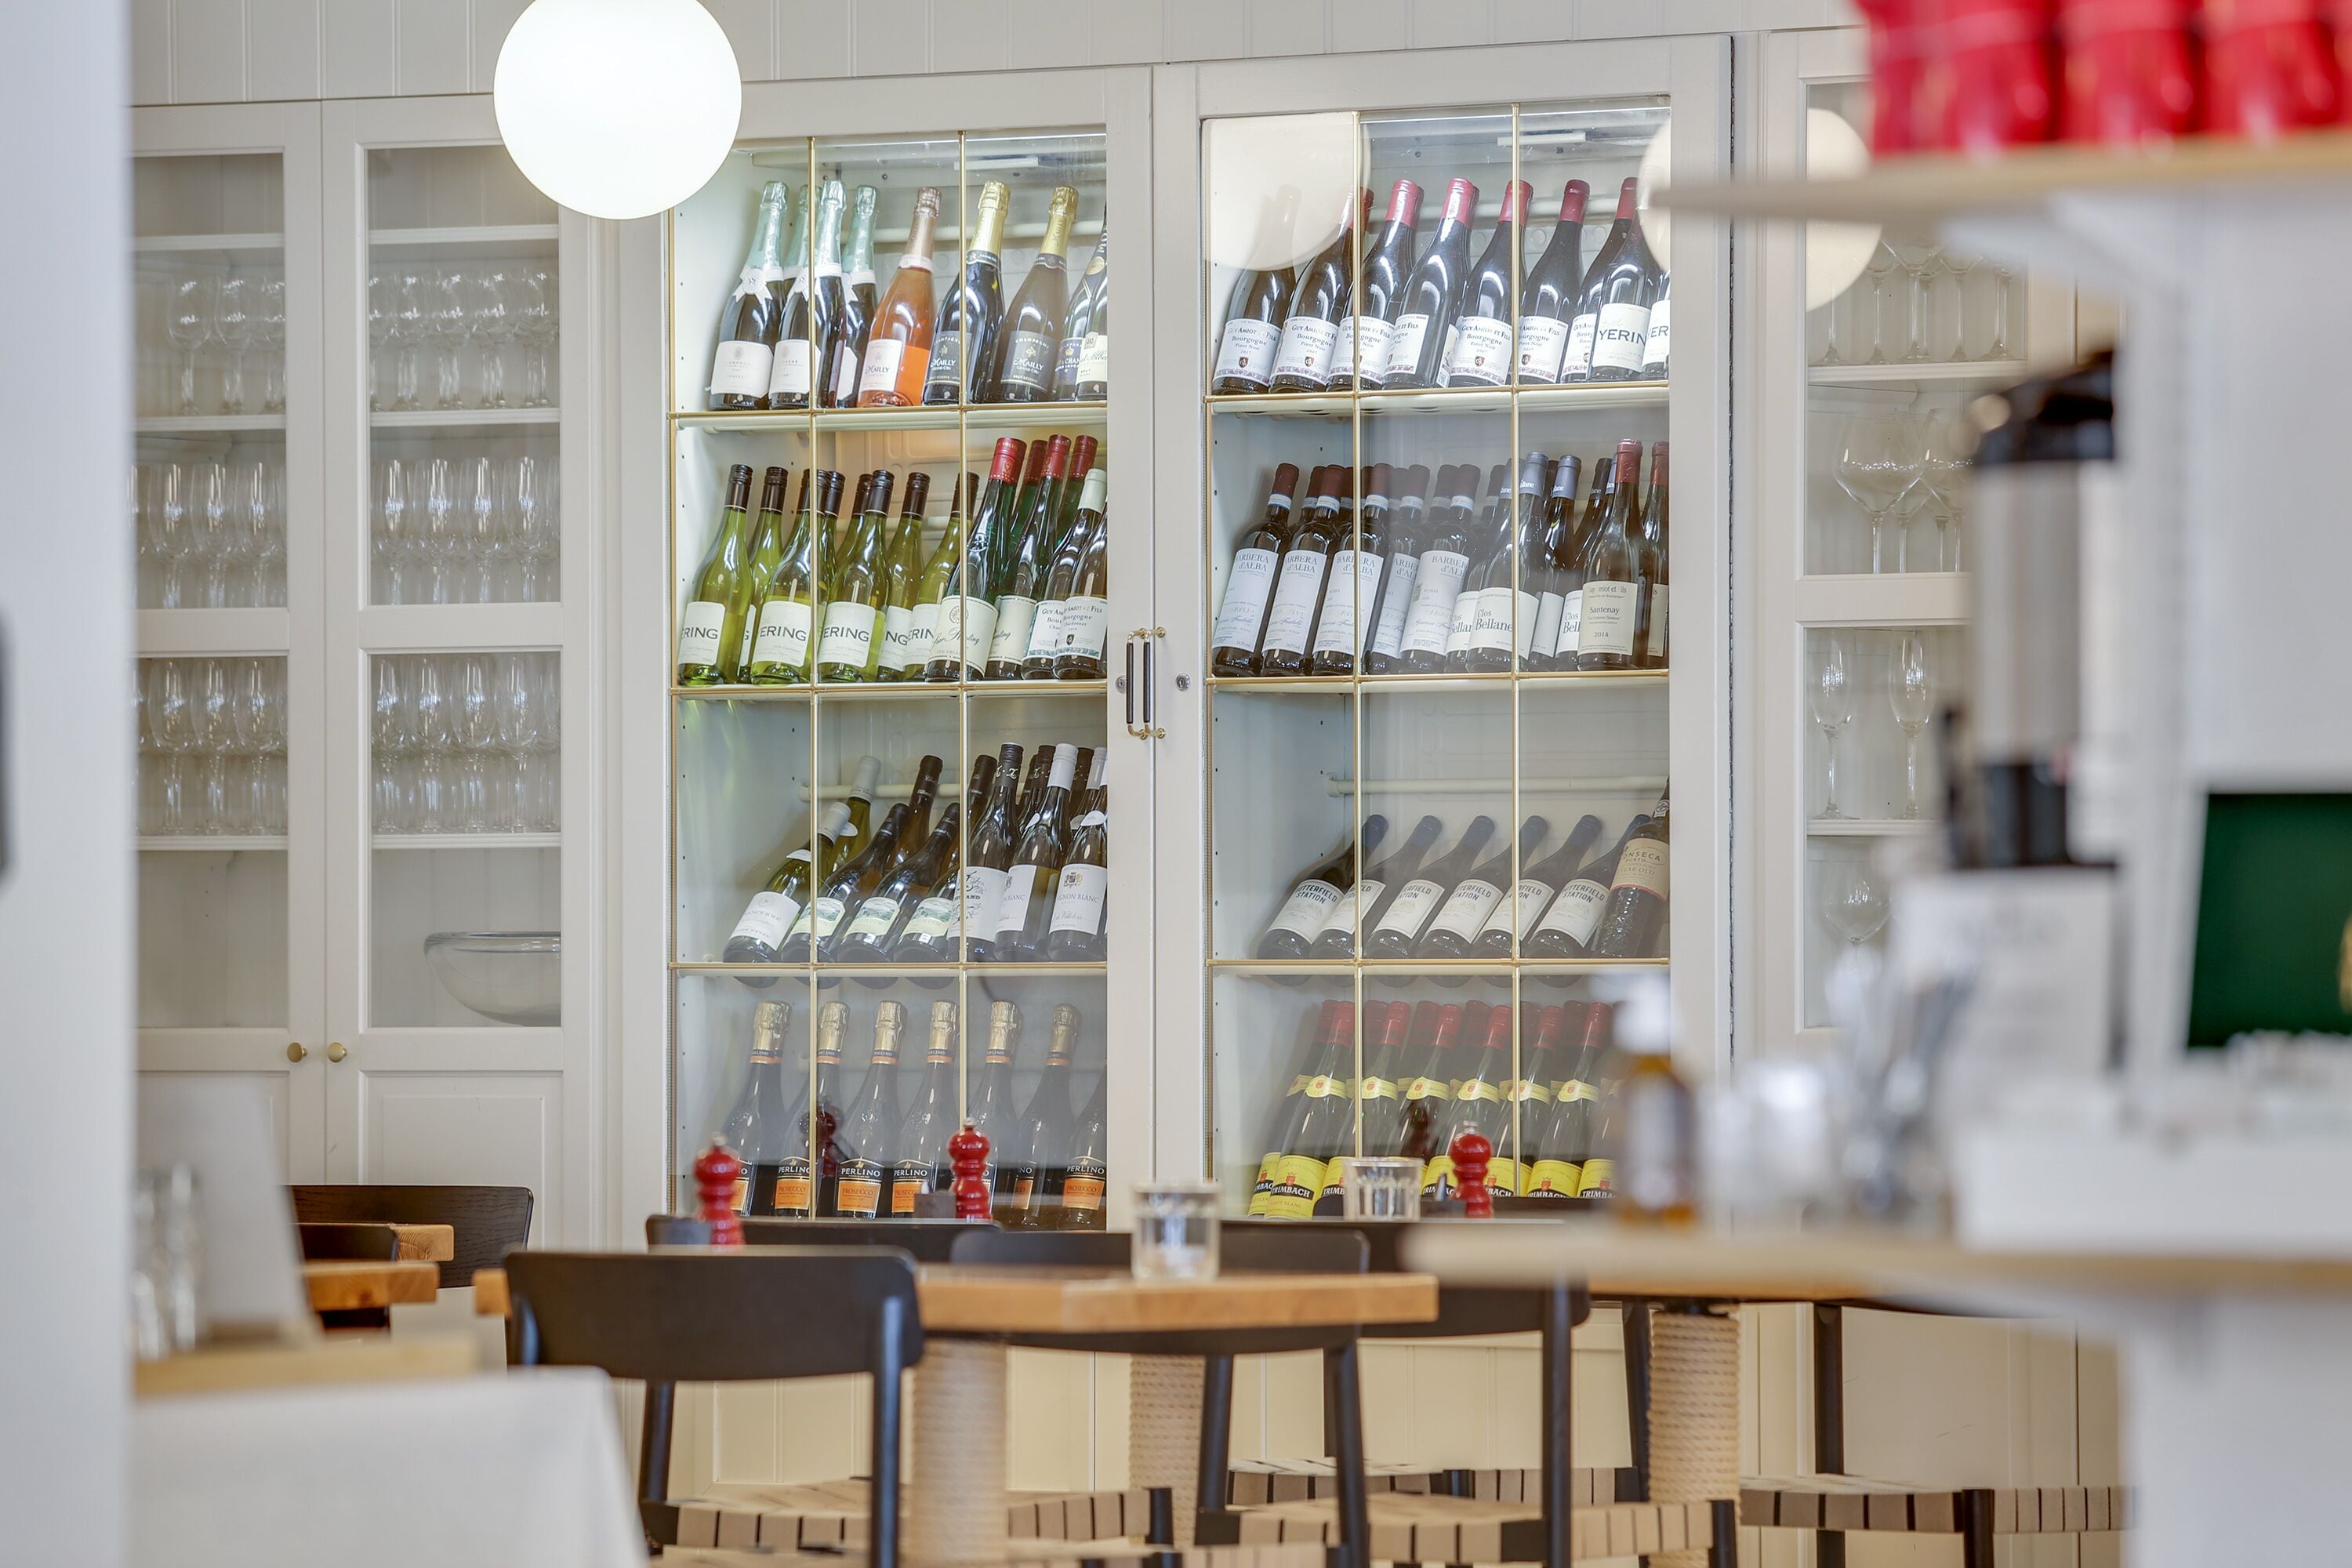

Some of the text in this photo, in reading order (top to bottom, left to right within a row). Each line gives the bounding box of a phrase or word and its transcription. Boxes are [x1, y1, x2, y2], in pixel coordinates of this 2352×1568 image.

[1232, 336, 1268, 347] Bourgogne
[1297, 332, 1332, 347] Bourgogne
[1345, 332, 1381, 343] Bogogne
[1467, 333, 1503, 346] Bourgogne
[1239, 562, 1267, 572] d'ALBA
[1287, 564, 1316, 574] d'ALBA
[1091, 604, 1103, 614] FILS
[1477, 608, 1493, 618] Clos
[1589, 606, 1620, 615] Santenay
[1565, 612, 1579, 621] Clos
[759, 626, 808, 642] ERING
[1622, 851, 1661, 862] ONSECA
[1296, 891, 1327, 904] STATION
[841, 1167, 880, 1178] PERLINO
[1066, 1165, 1105, 1175] PERLINO
[1272, 1184, 1311, 1198] TRIMBACH
